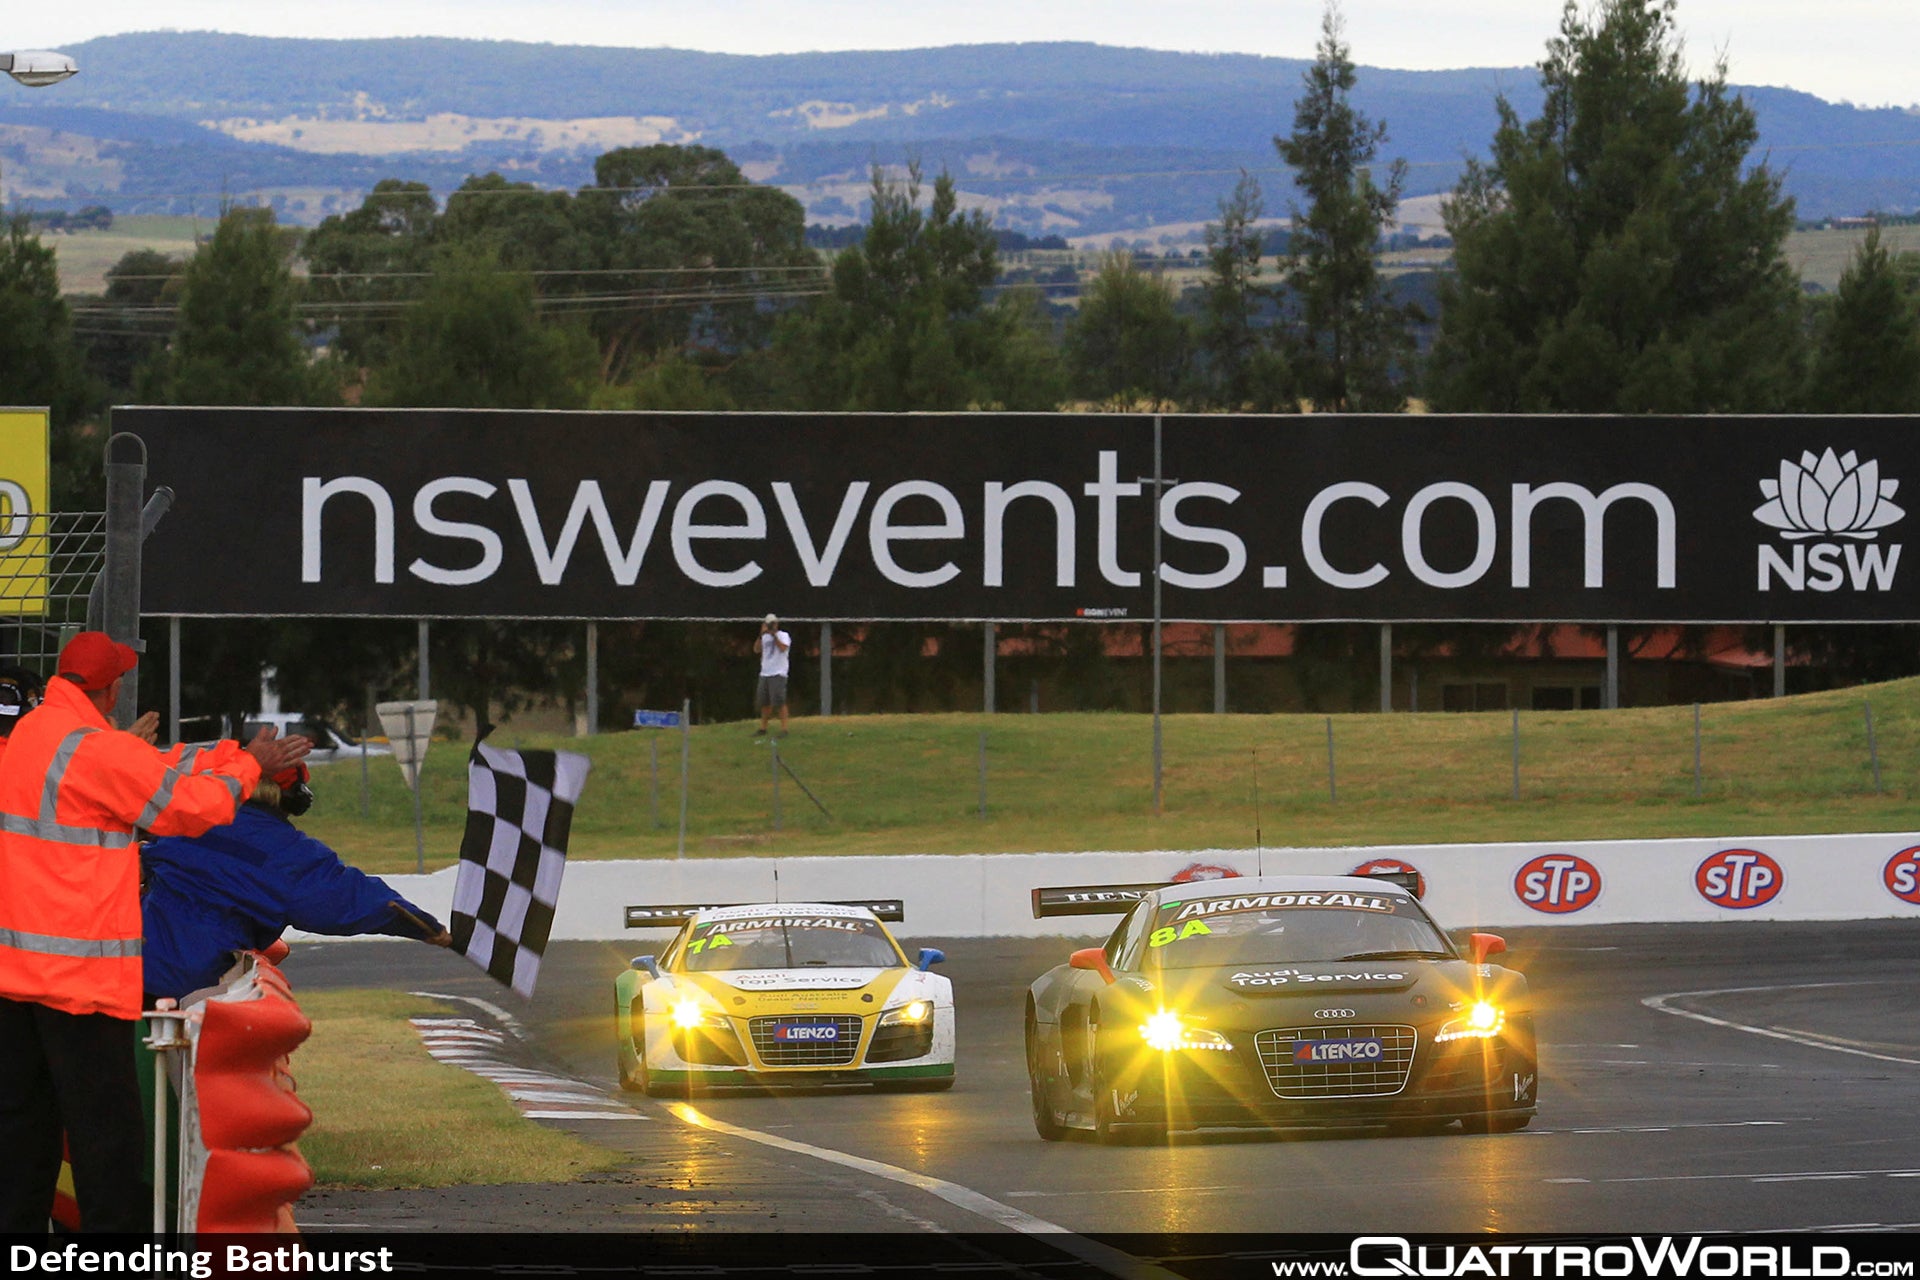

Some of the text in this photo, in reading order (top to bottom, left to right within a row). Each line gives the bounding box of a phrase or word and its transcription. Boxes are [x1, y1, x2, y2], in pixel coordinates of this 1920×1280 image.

[303, 451, 1675, 589] nswevents.com
[1758, 543, 1902, 592] NSW
[1523, 860, 1591, 904] STP
[1705, 855, 1774, 899] STP
[1065, 891, 1151, 902] HEN
[1176, 893, 1387, 921] ARMORALL
[706, 918, 858, 936] ARMORALL
[1150, 919, 1212, 948] 8A
[687, 934, 733, 954] 7A
[1231, 969, 1299, 979] Audi
[1231, 972, 1404, 986] Top Service
[1296, 1041, 1380, 1061] ALTENZO
